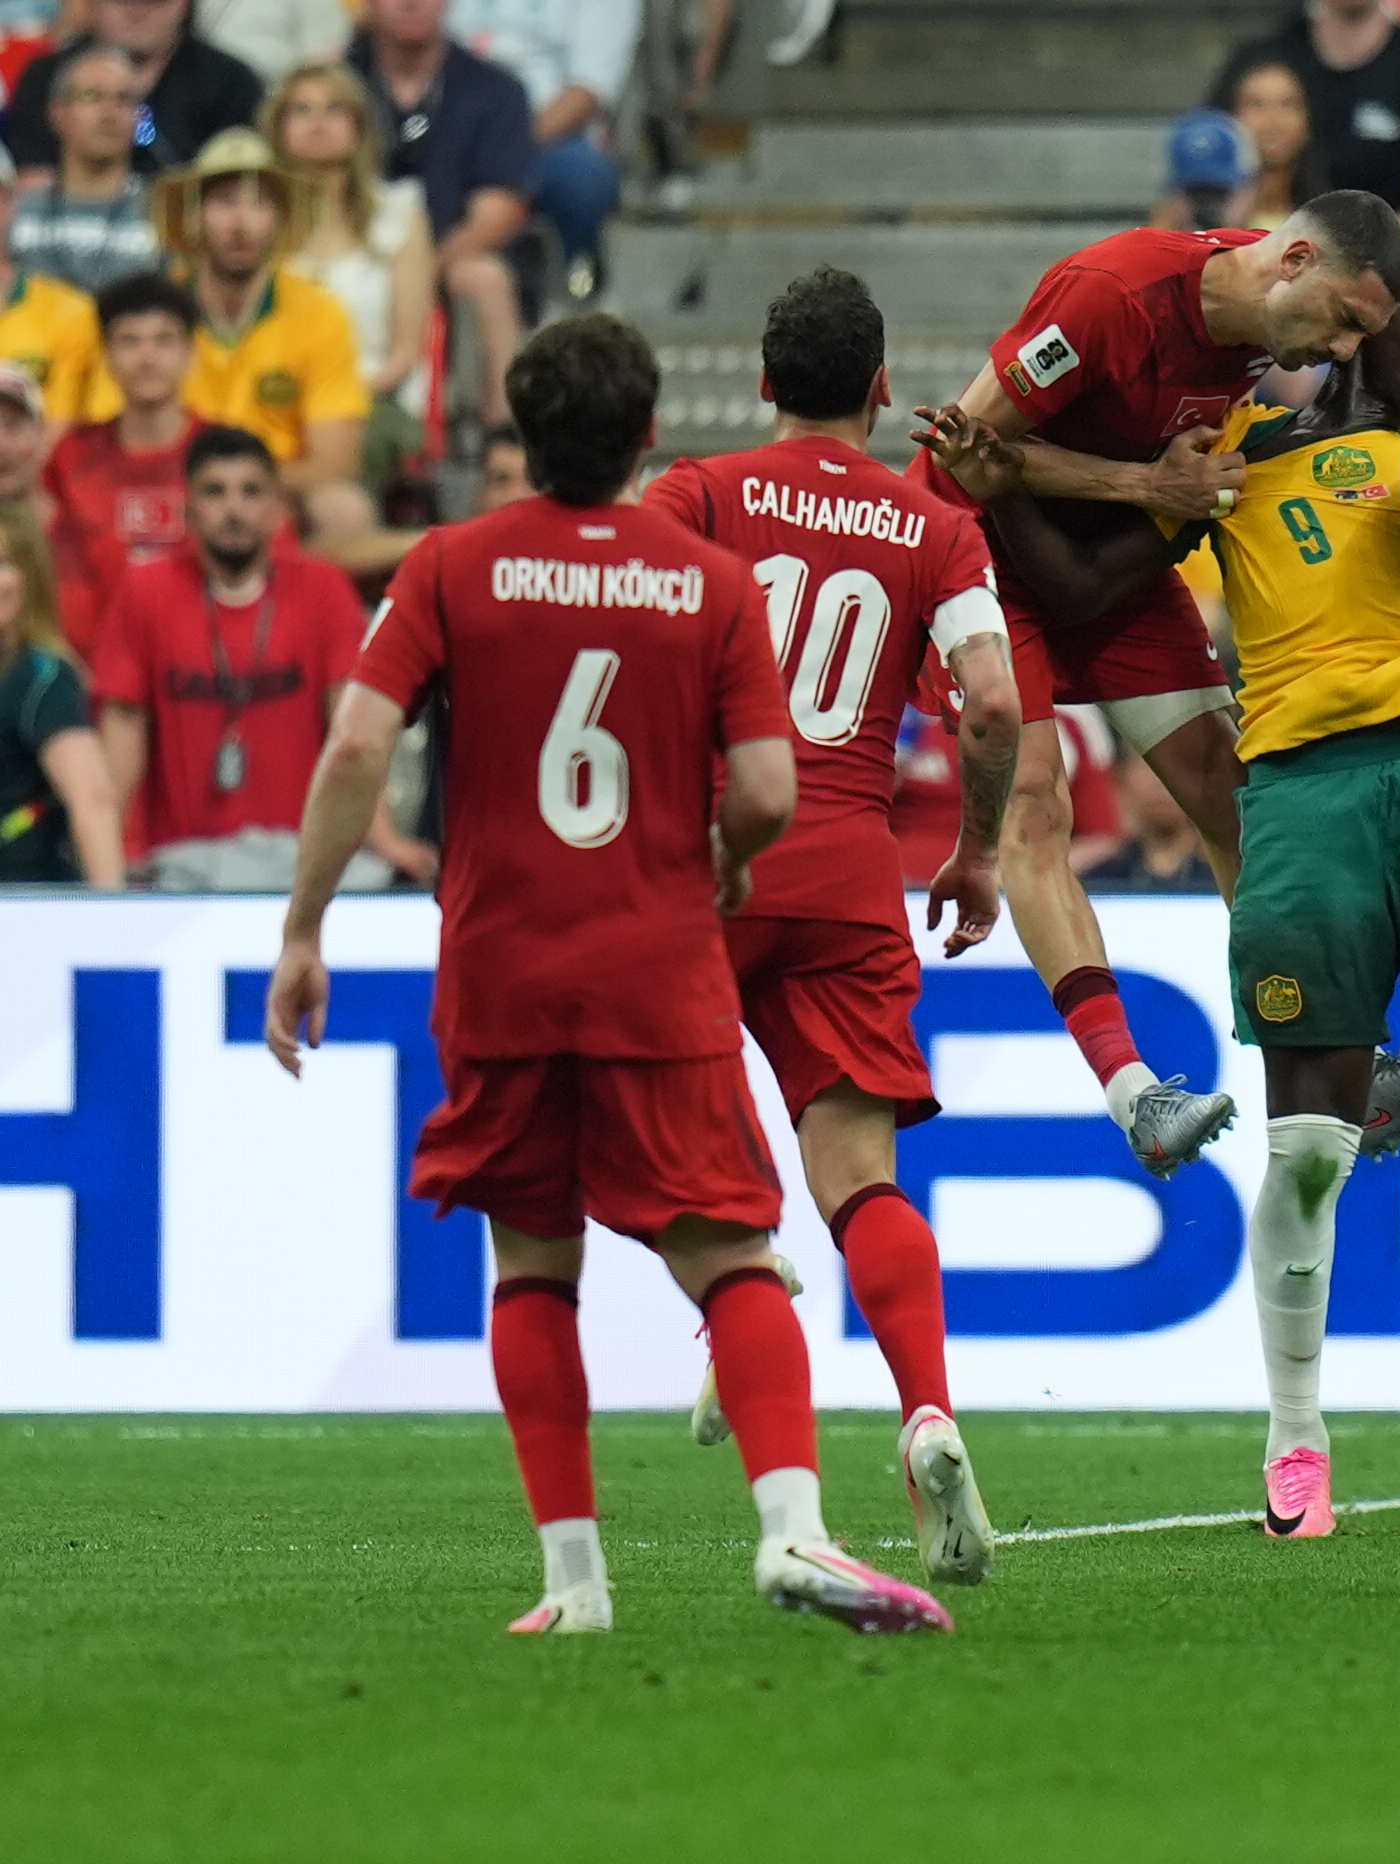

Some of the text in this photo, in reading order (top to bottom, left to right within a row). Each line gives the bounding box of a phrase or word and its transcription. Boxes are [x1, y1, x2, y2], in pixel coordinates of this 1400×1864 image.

[742, 476, 926, 549] ÇALHANOĞLU
[1278, 497, 1333, 565] 9
[492, 556, 705, 617] ORKUN KÖKÇÜ
[752, 553, 892, 747] 10
[538, 648, 630, 849] 6
